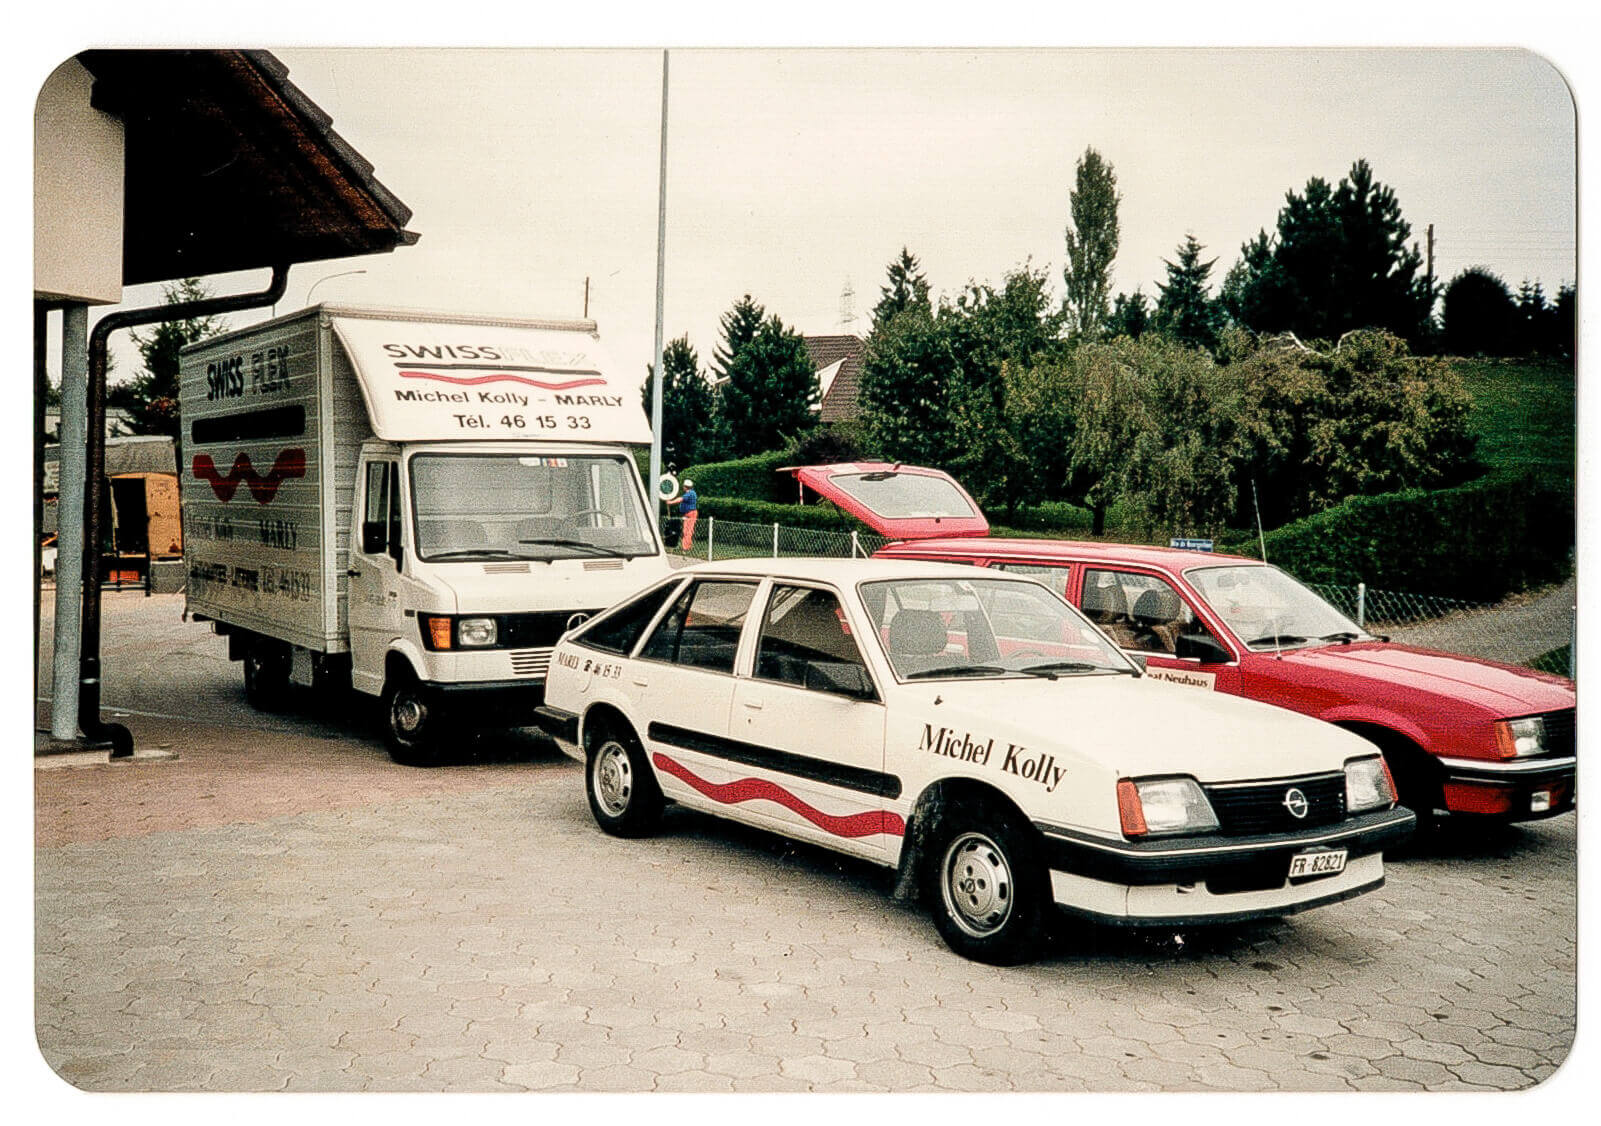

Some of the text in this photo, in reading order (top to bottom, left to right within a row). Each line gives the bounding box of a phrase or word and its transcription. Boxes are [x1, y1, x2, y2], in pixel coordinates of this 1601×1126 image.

[206, 355, 244, 401] SWISS
[394, 389, 469, 404] Michel
[478, 391, 529, 407] Kolly
[554, 394, 623, 408] MARLY
[453, 413, 592, 430] Tél. 46 15 33
[1164, 673, 1209, 688] Neuhaus
[918, 723, 1068, 793] Michel Kolly
